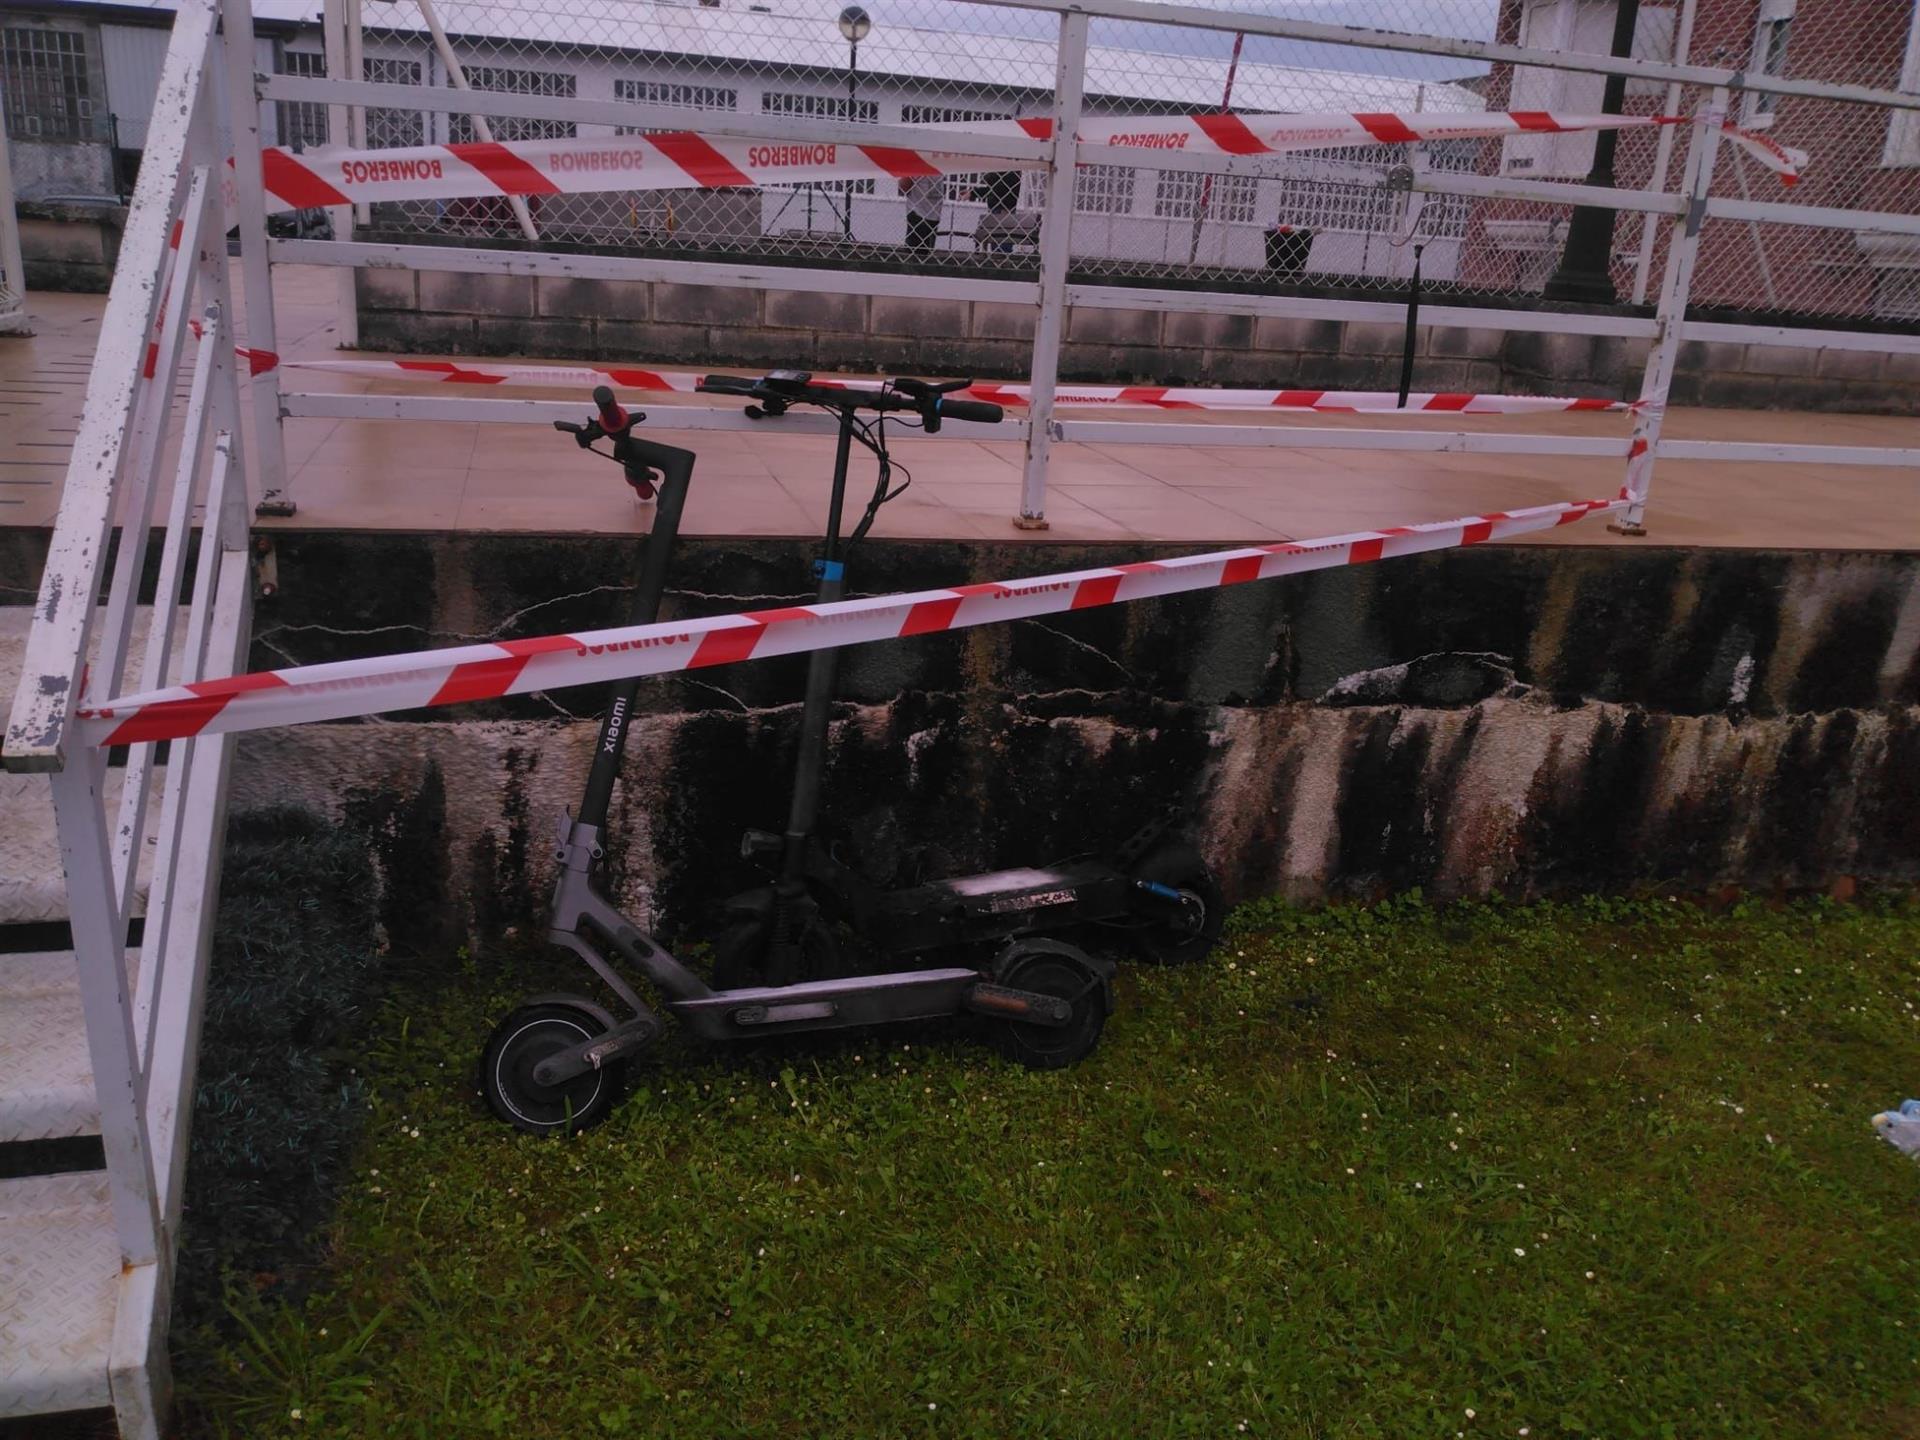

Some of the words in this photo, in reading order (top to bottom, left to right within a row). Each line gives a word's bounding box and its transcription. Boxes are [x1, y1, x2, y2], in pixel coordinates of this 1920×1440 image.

[748, 144, 837, 168] BOMBEROS
[341, 159, 443, 184] BOMBEROS
[603, 696, 627, 753] xiaomi
